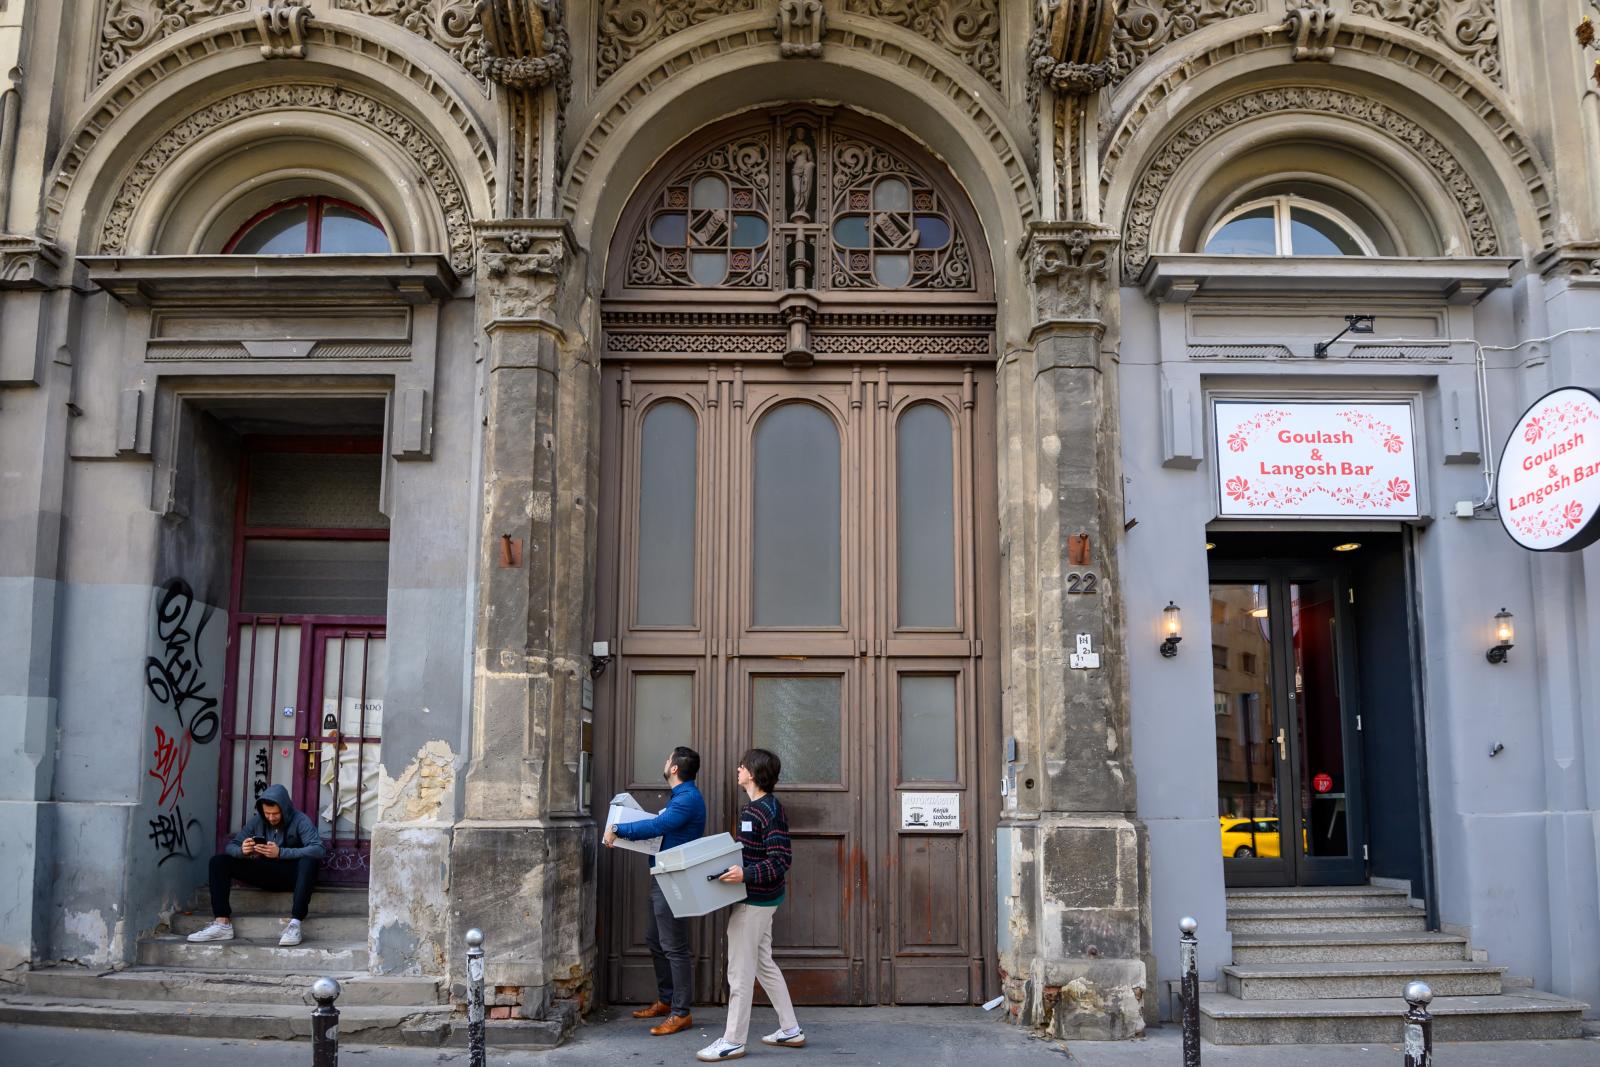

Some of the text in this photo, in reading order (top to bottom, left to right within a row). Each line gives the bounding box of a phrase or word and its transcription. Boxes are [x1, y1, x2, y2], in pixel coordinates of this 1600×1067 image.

[1277, 430, 1353, 444] Goulash
[1310, 448, 1323, 461] &
[1522, 432, 1584, 471] Goulash
[1260, 462, 1374, 479] Langosh Bar
[1548, 464, 1559, 479] &
[1509, 474, 1570, 511] Langosh
[1067, 573, 1097, 594] 22
